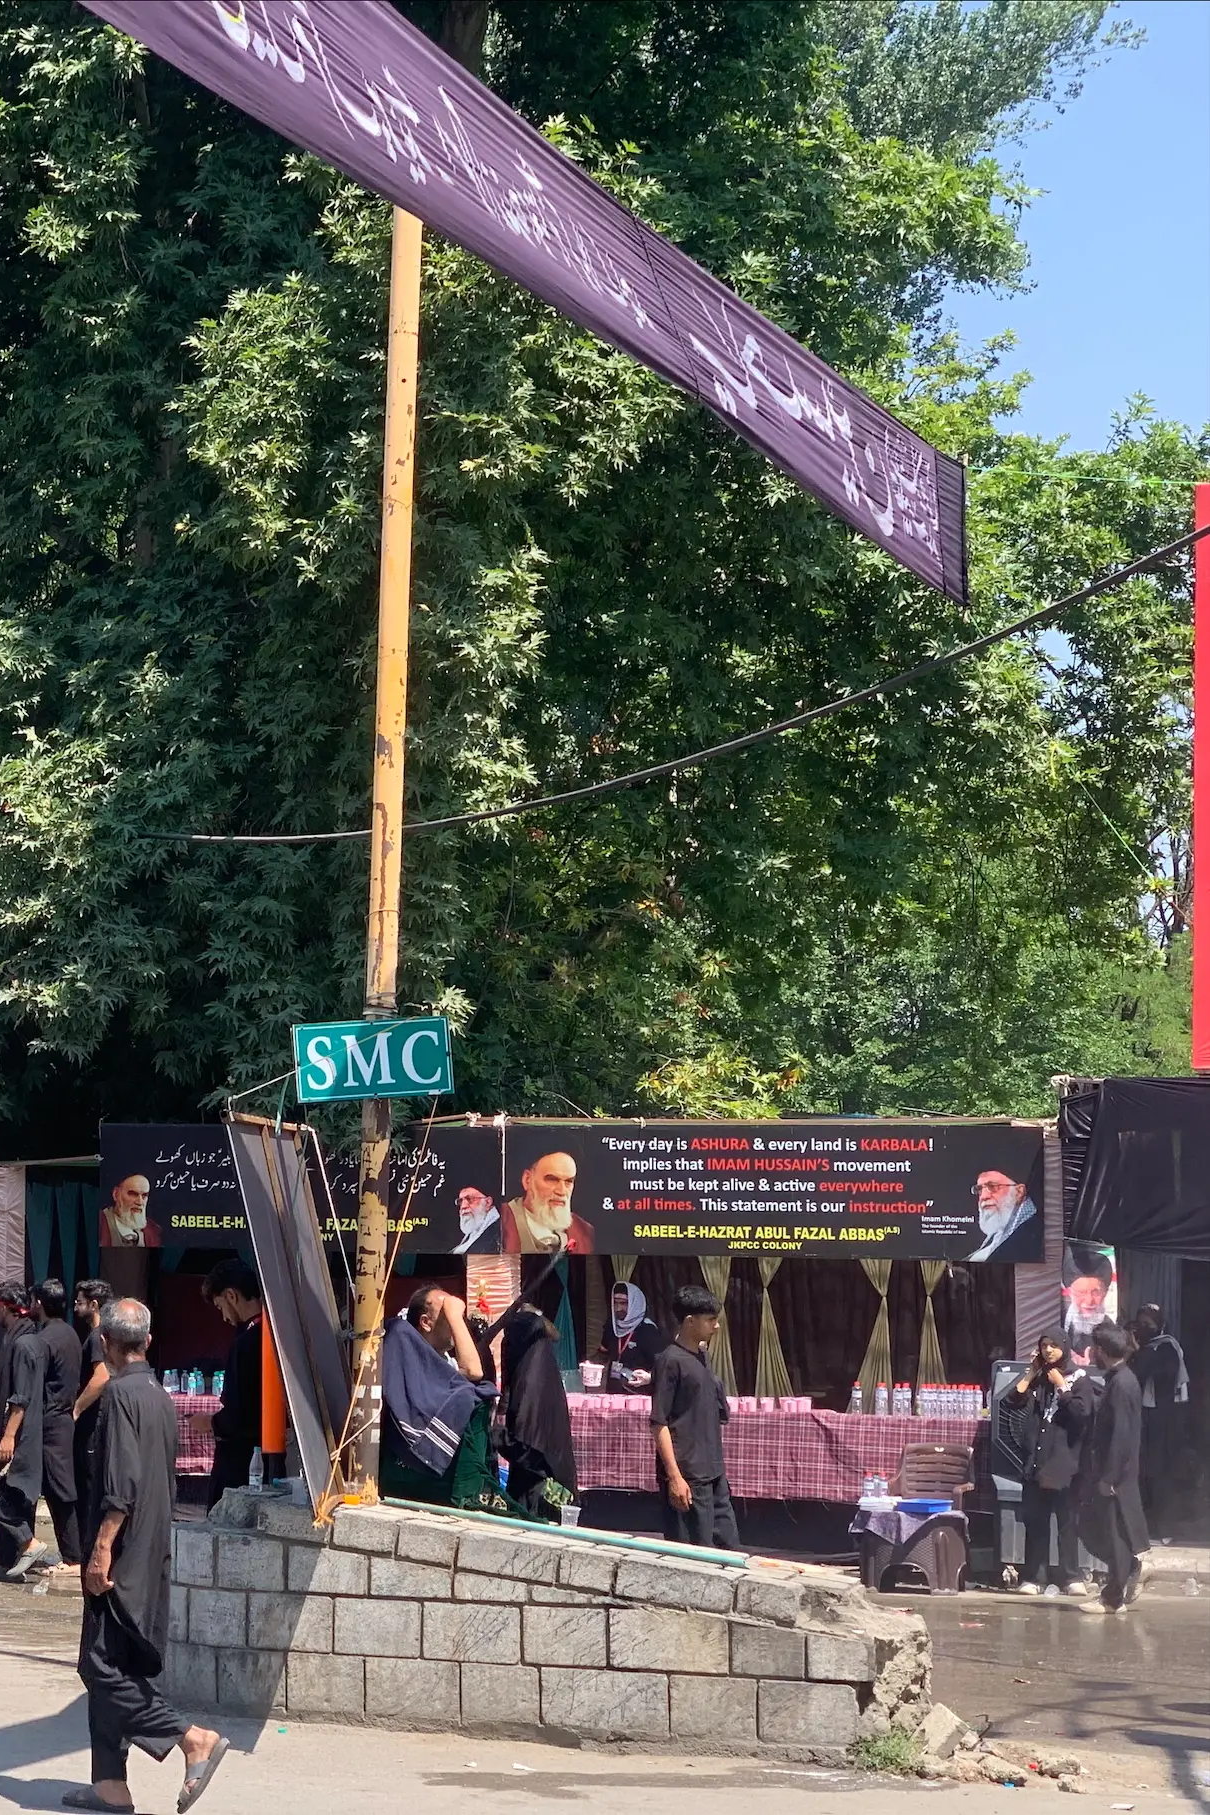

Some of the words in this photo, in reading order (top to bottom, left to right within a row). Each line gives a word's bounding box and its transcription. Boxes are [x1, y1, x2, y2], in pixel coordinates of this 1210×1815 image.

[307, 1030, 442, 1091] SMC
[648, 1137, 673, 1153] day
[677, 1138, 687, 1150] is
[691, 1138, 749, 1150] ASHURA
[753, 1138, 765, 1151] &
[768, 1140, 808, 1154] every
[811, 1138, 842, 1151] land
[846, 1138, 857, 1151] is
[861, 1138, 934, 1151] KARBALA!
[623, 1157, 672, 1173] implies
[675, 1158, 704, 1171] that
[708, 1158, 750, 1171] IMAM
[834, 1160, 911, 1172] movement
[630, 1179, 664, 1191] must
[668, 1178, 685, 1191] be
[688, 1178, 719, 1193] kept
[722, 1178, 755, 1191] alive
[758, 1179, 770, 1192] &
[773, 1179, 816, 1192] active
[819, 1180, 904, 1195] everywhere
[602, 1197, 614, 1210] &
[617, 1199, 631, 1210] at
[635, 1198, 650, 1210] all
[654, 1198, 696, 1211] times.
[699, 1198, 728, 1211] This
[731, 1199, 802, 1212] statement
[806, 1200, 817, 1212] is
[821, 1202, 845, 1212] our
[171, 1215, 247, 1229] SABEEL-E-H
[326, 1218, 359, 1231] FAZA
[634, 1225, 752, 1239] SABEEL-E-HAZRAT
[755, 1226, 790, 1239] ABUL
[794, 1227, 835, 1240] FAZAL
[728, 1241, 760, 1249] JKPCC
[762, 1242, 802, 1250] COLONY
